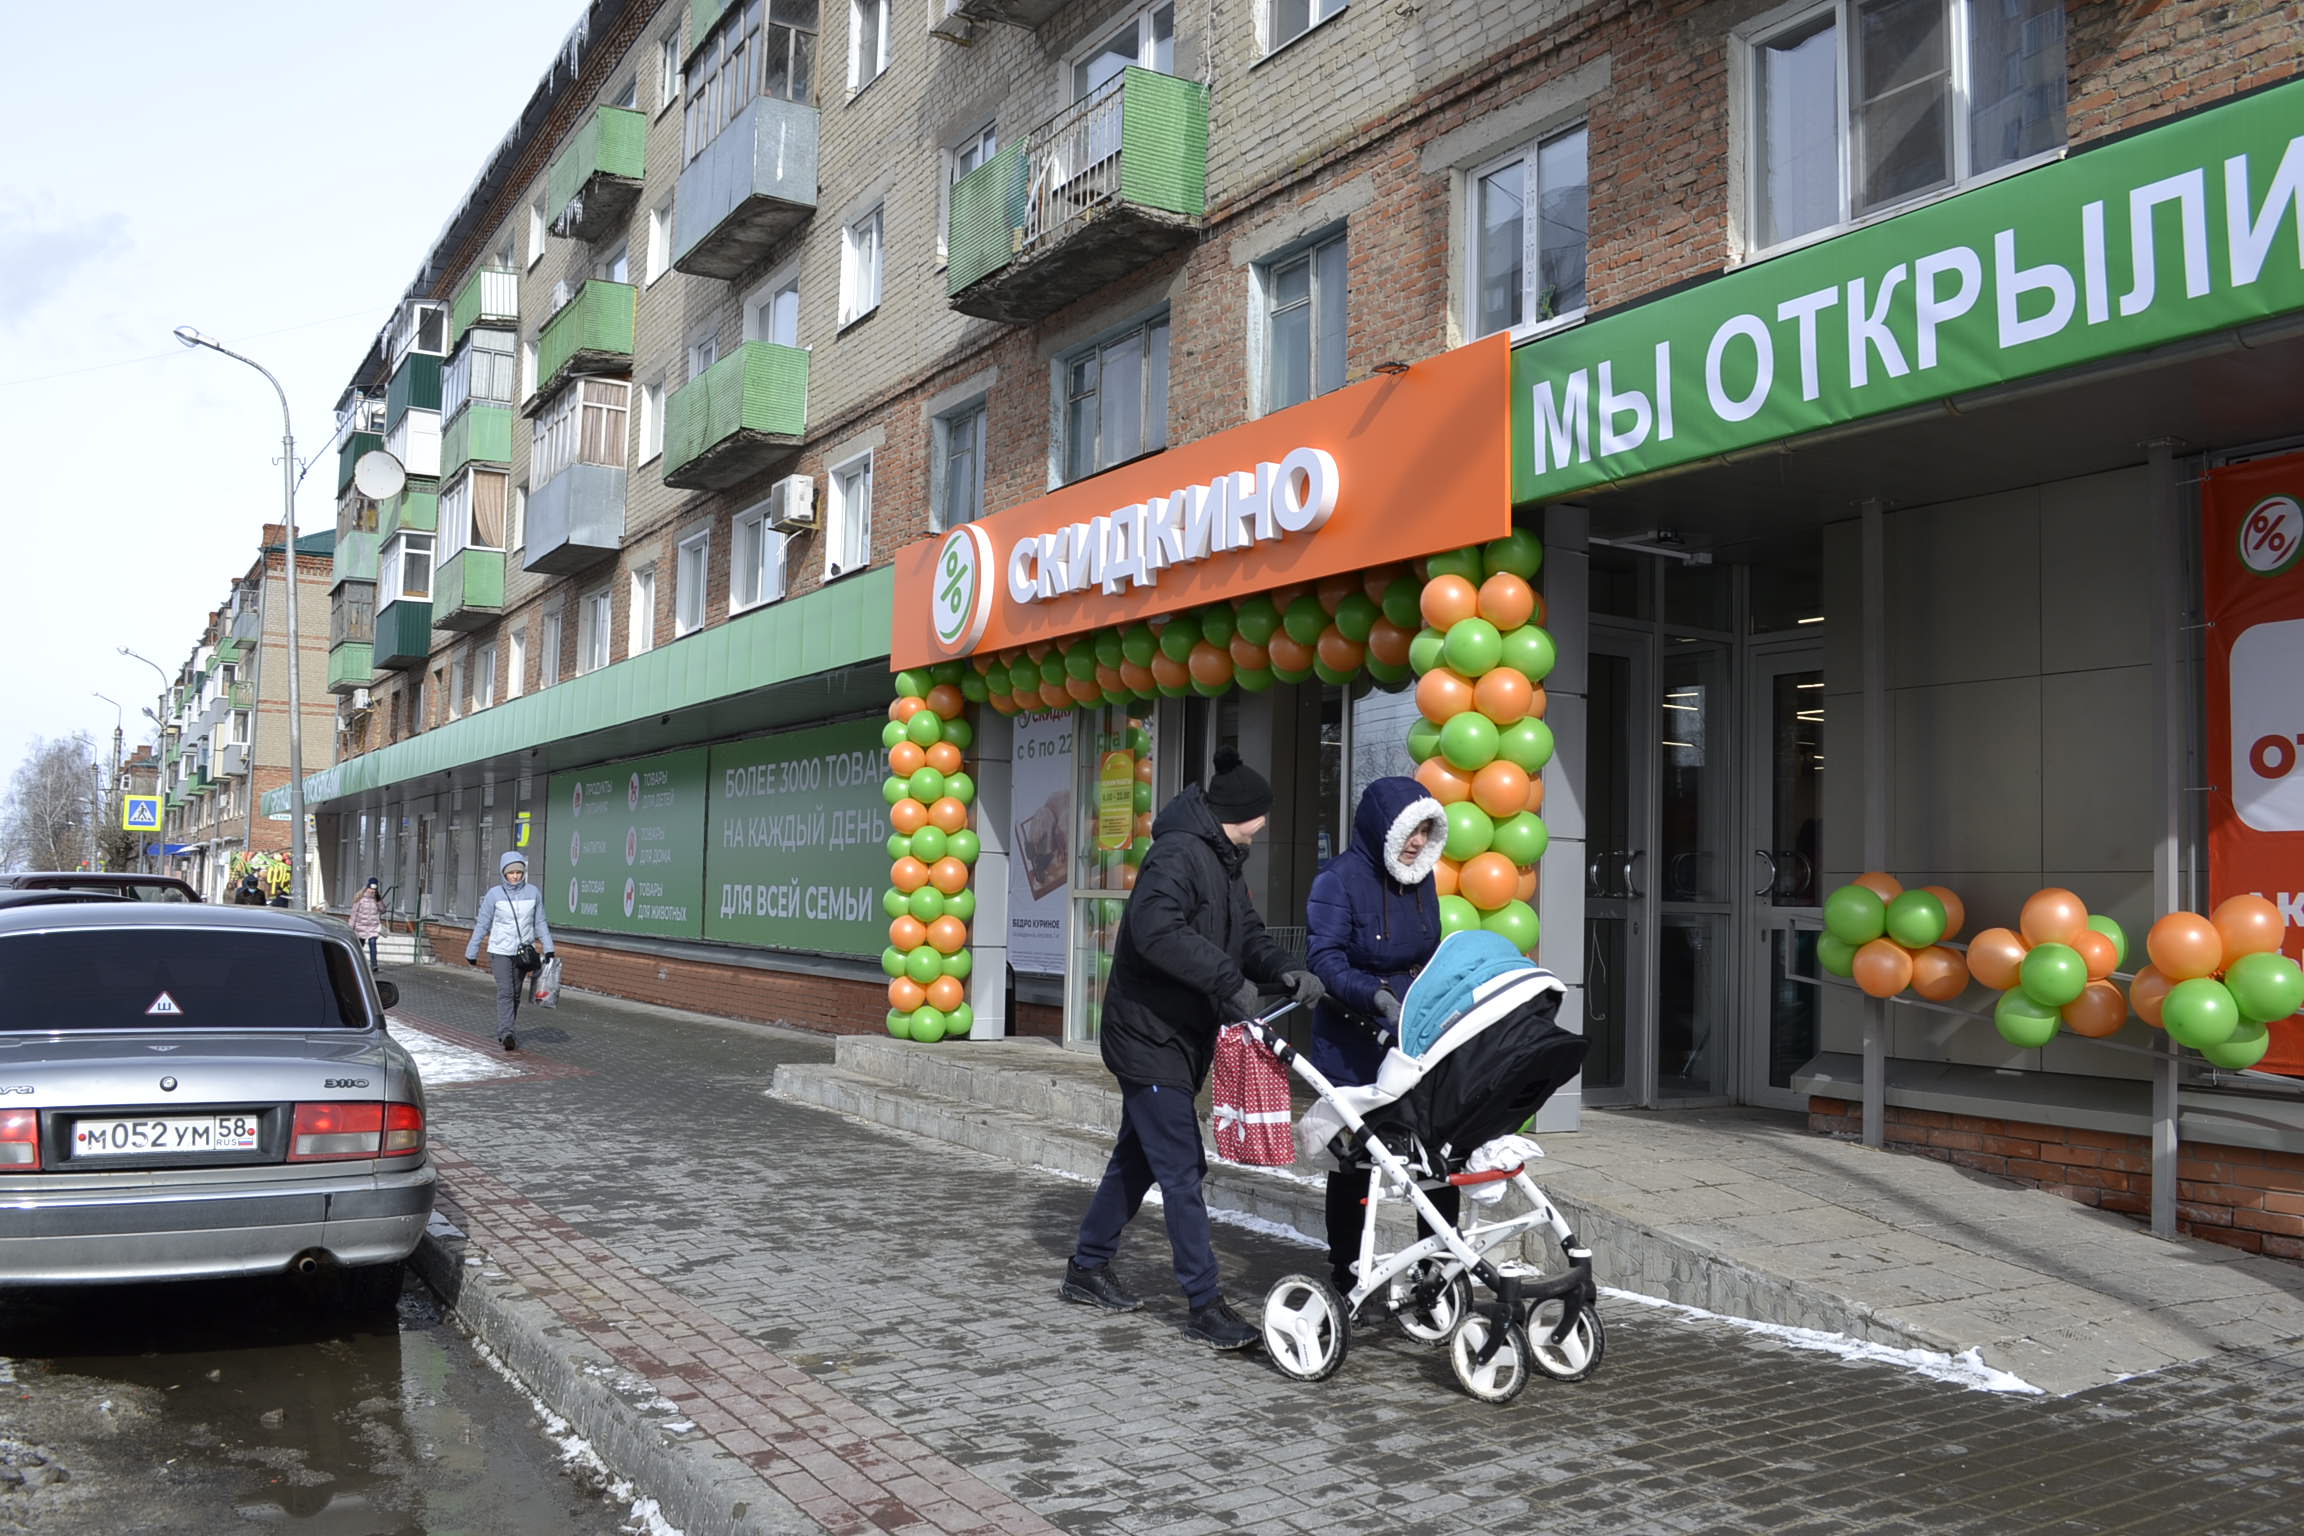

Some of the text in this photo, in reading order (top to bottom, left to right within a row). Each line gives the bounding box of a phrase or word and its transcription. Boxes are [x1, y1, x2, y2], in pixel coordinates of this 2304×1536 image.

[1531, 341, 1674, 475] МЫ
[1008, 446, 1339, 604] СКИДКИНО
[1027, 739, 1035, 759] 6
[1039, 740, 1055, 757] по
[644, 771, 668, 786] ТОВАРЫ
[725, 763, 776, 799] БОЛЕЕ
[780, 757, 821, 793] 3000
[723, 801, 885, 852] НА КАЖДЫЙ ДЕНЬ
[639, 882, 663, 897] ТОВАРЫ
[720, 876, 873, 922] ДЛЯ ВСЕЙ СЕМЬИ
[651, 905, 688, 921] ЖИВОТНЫХ
[1032, 919, 1060, 929] КУРИНОЕ
[218, 1117, 247, 1138] 58
[216, 1138, 238, 1146] RUS
